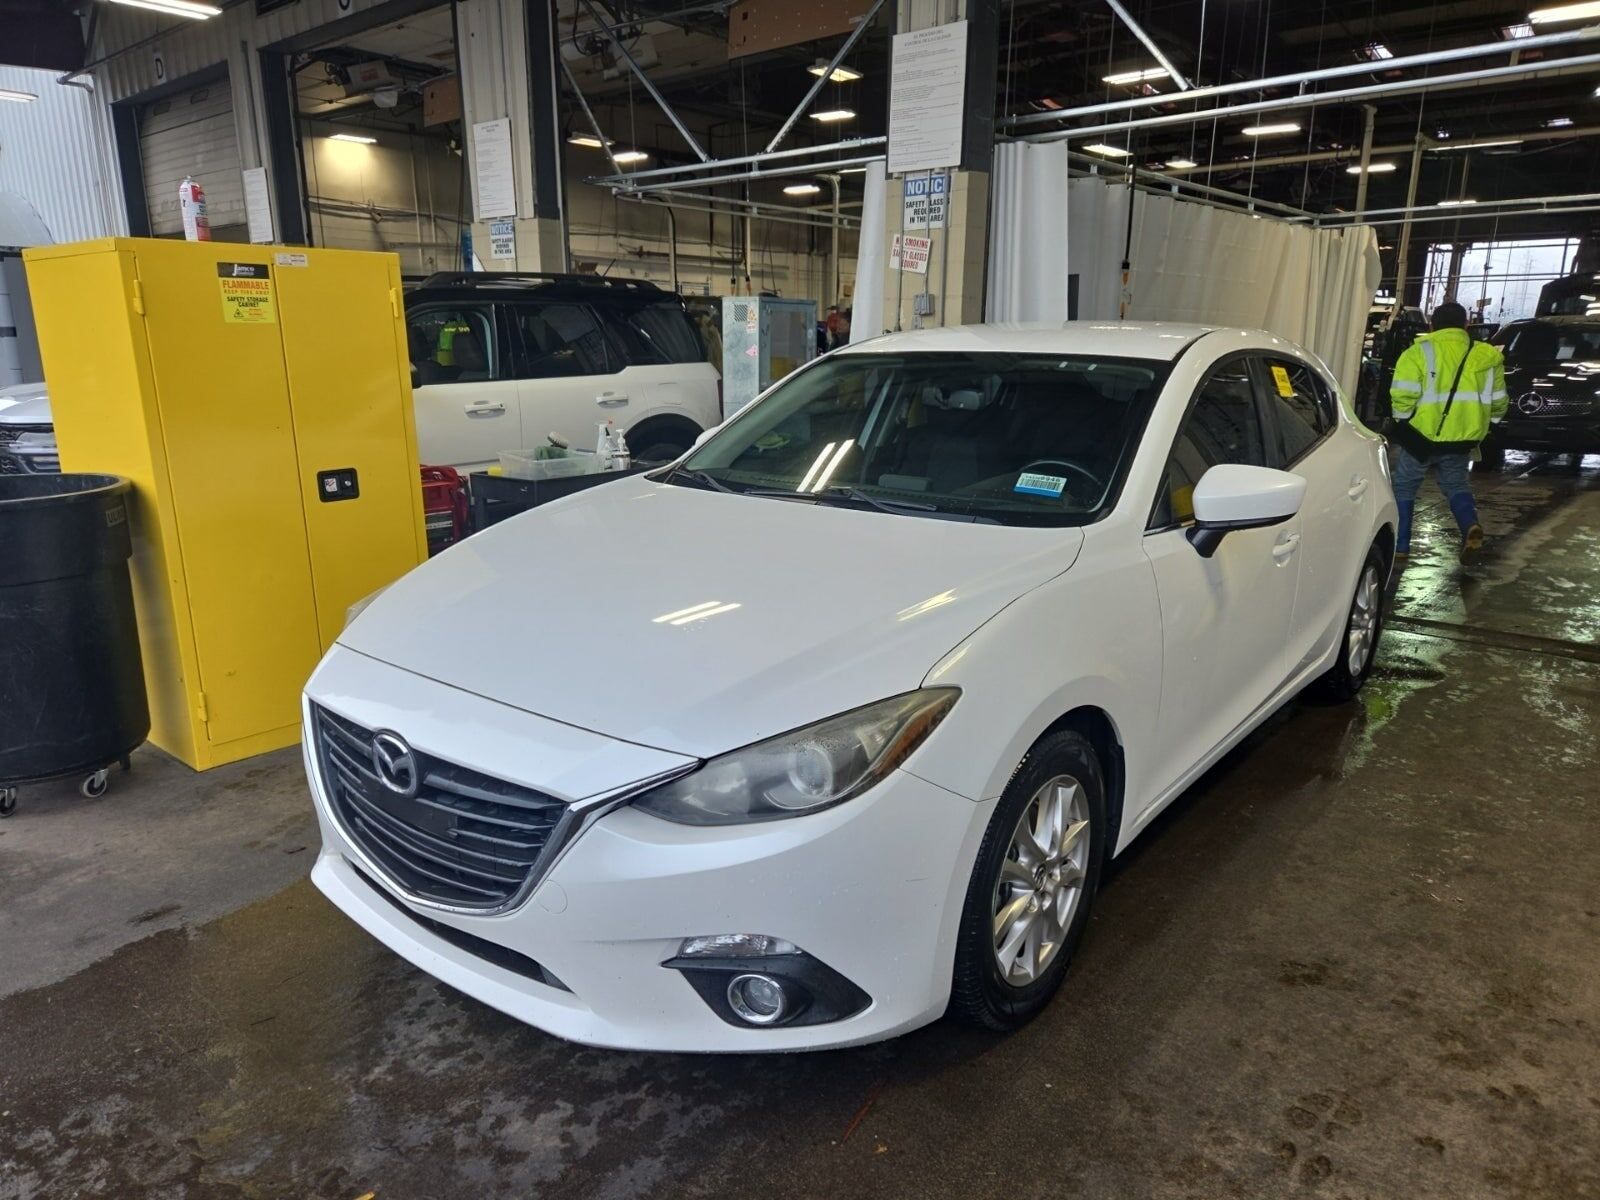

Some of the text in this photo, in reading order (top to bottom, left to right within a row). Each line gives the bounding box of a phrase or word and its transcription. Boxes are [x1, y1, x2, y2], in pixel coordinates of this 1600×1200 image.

[905, 200, 925, 208] SAFETY
[905, 237, 928, 249] SMOKING
[909, 251, 927, 262] GLASSES
[222, 279, 269, 290] FLAMMABLE
